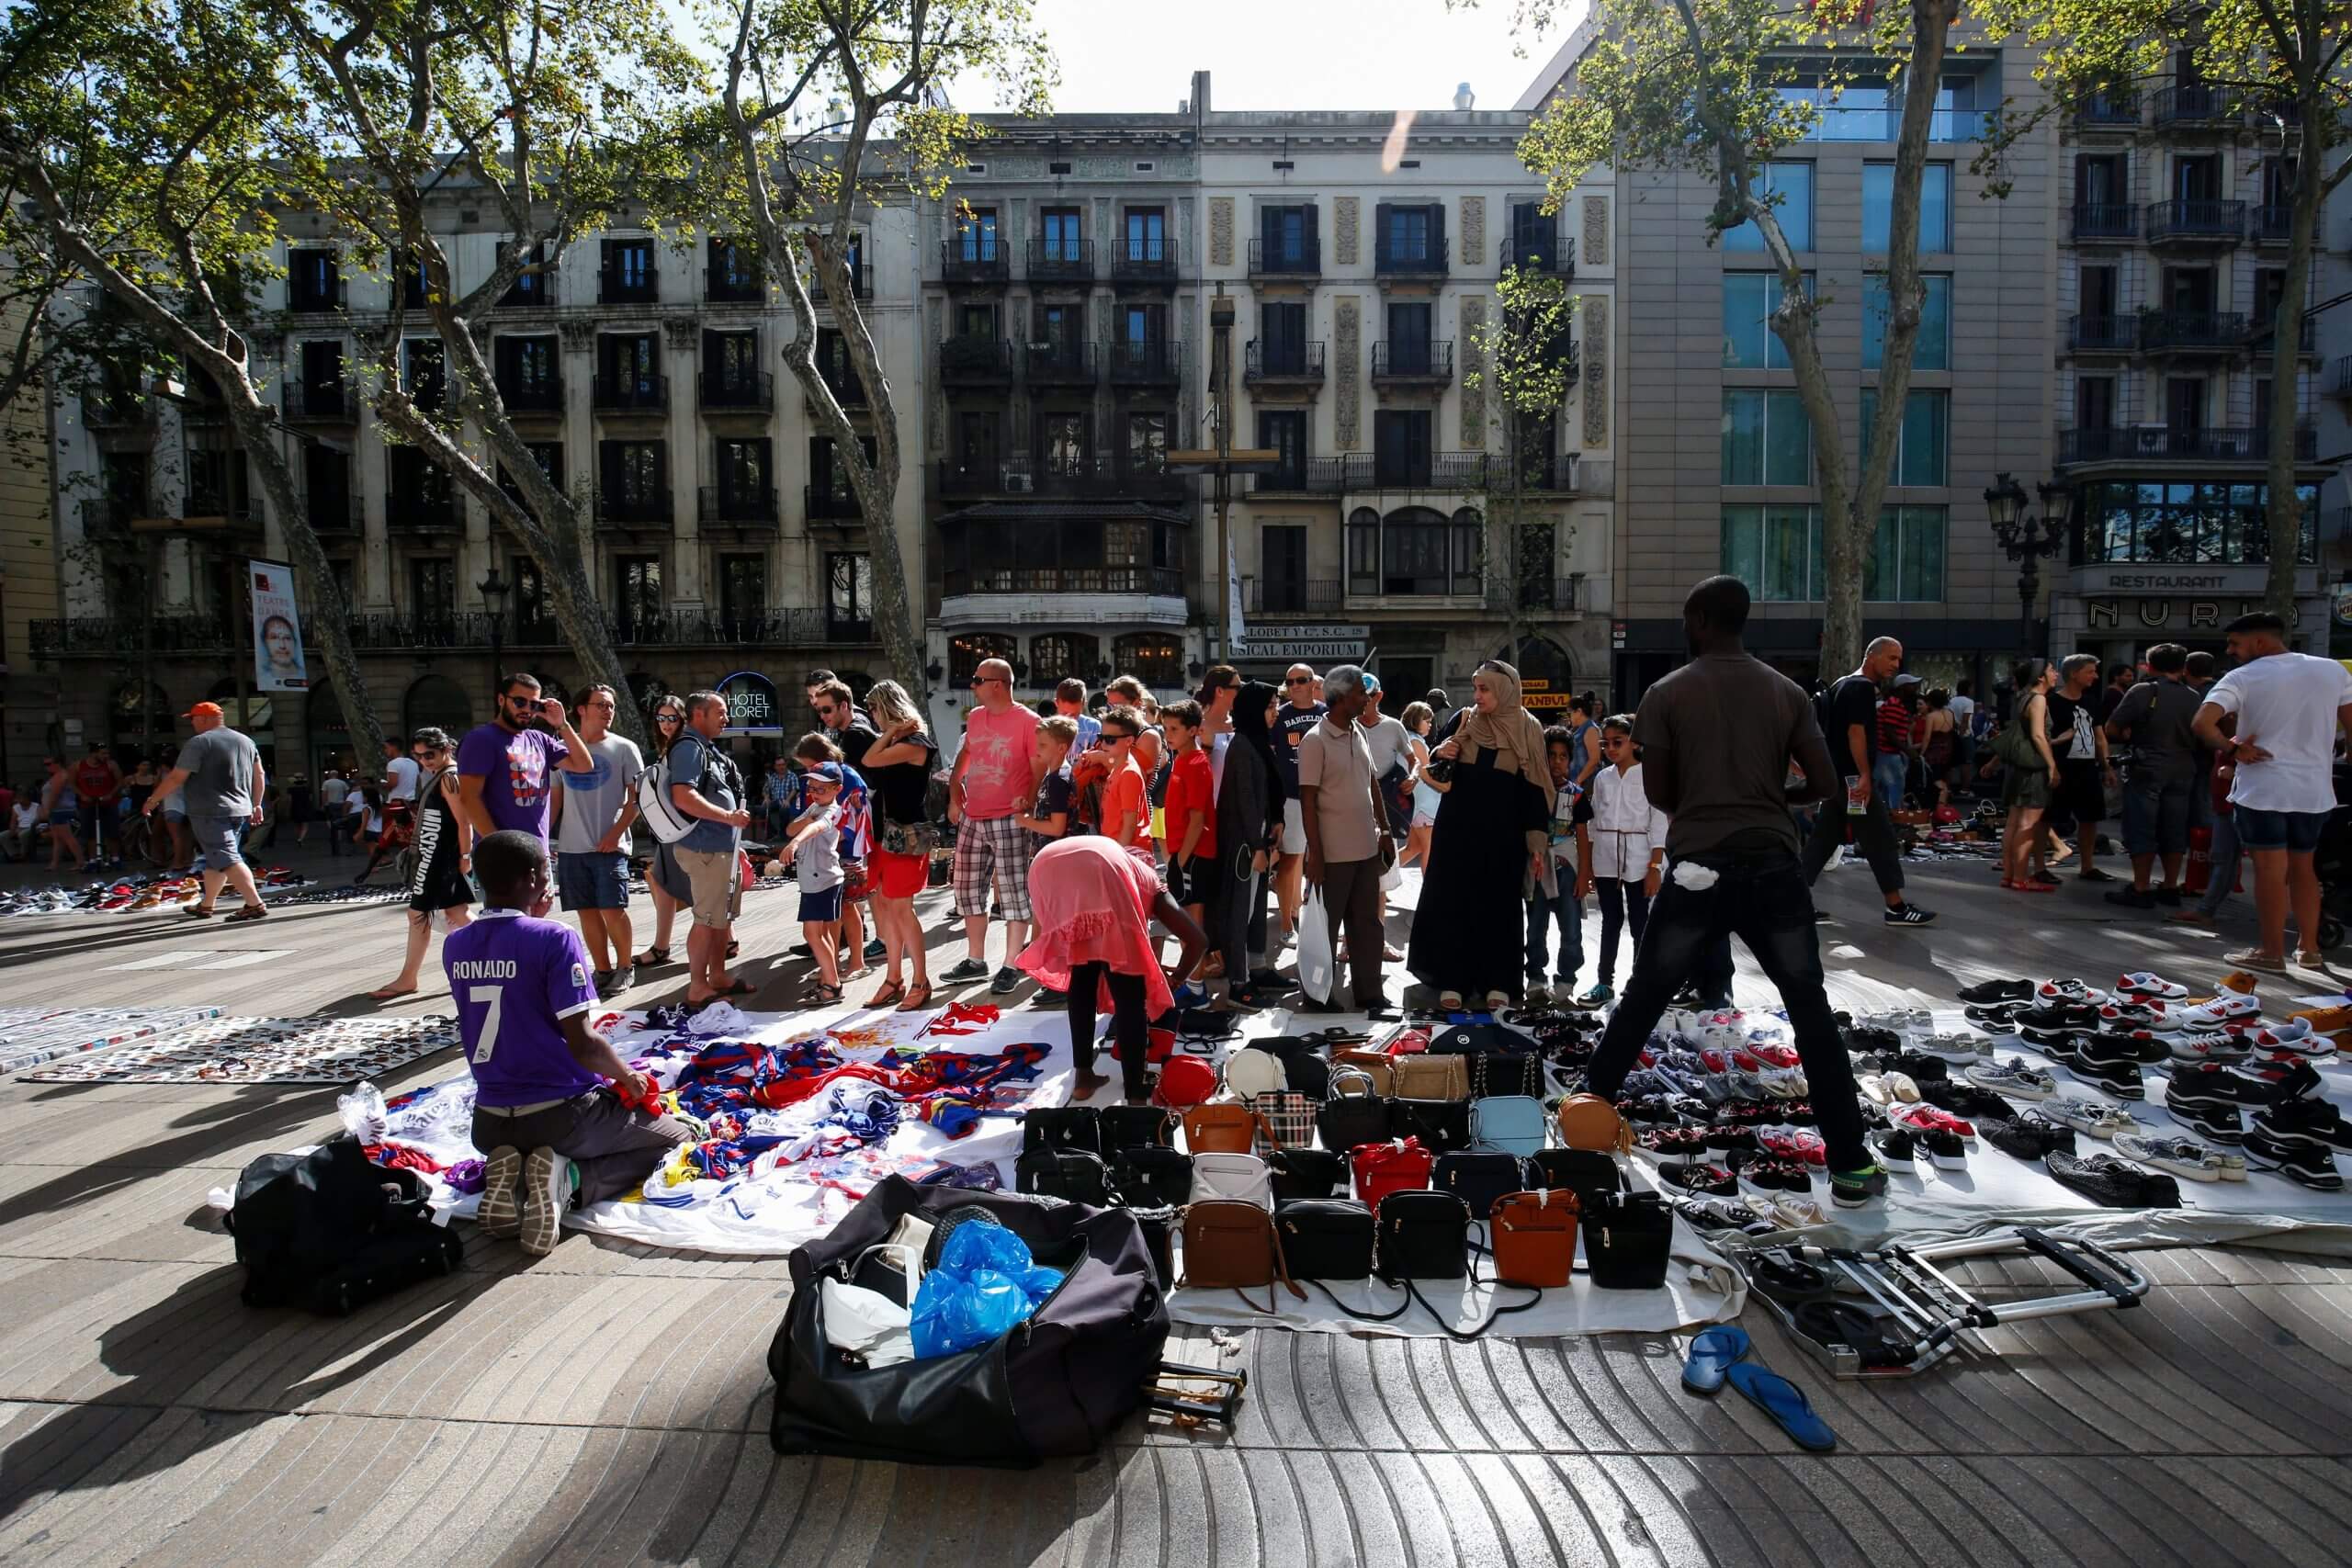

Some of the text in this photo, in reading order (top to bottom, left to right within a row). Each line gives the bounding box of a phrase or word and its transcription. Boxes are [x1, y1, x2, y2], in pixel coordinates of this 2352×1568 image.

[2109, 576, 2227, 588] RESTAURANT
[2088, 602, 2299, 626] NURI
[1246, 627, 1292, 637] LOBET
[1228, 645, 1357, 656] USICAL EMPORIUM
[727, 694, 770, 705] HOTEL
[728, 705, 771, 718] LORET
[1283, 715, 1323, 728] BARCELO
[453, 960, 516, 979] RONALDO
[469, 985, 503, 1065] 7
